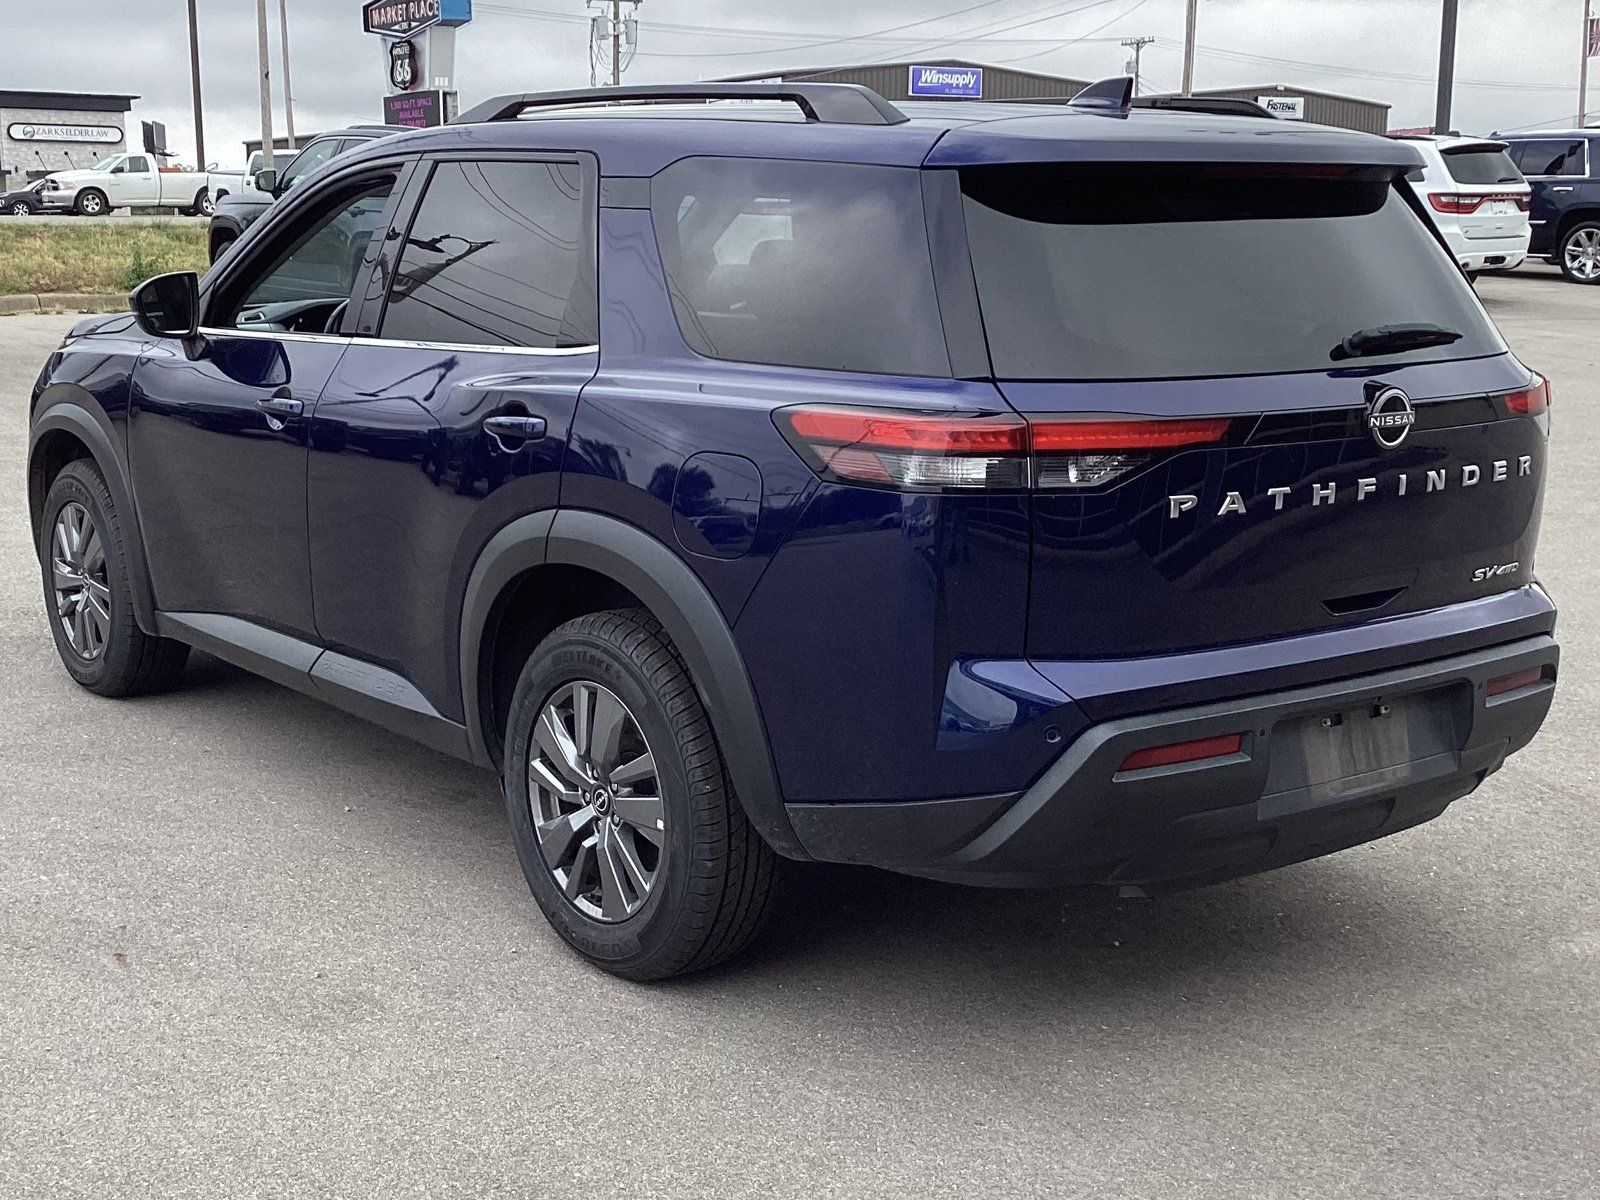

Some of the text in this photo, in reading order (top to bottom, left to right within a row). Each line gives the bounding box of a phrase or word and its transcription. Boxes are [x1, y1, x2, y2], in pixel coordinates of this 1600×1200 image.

[372, 0, 439, 26] MARKET PLACE
[394, 59, 411, 82] 66
[920, 69, 977, 88] Winsupply
[91, 128, 109, 138] LAW
[1369, 412, 1416, 427] NISSAN
[1168, 455, 1534, 519] PATHFINDER
[1471, 565, 1498, 582] SV
